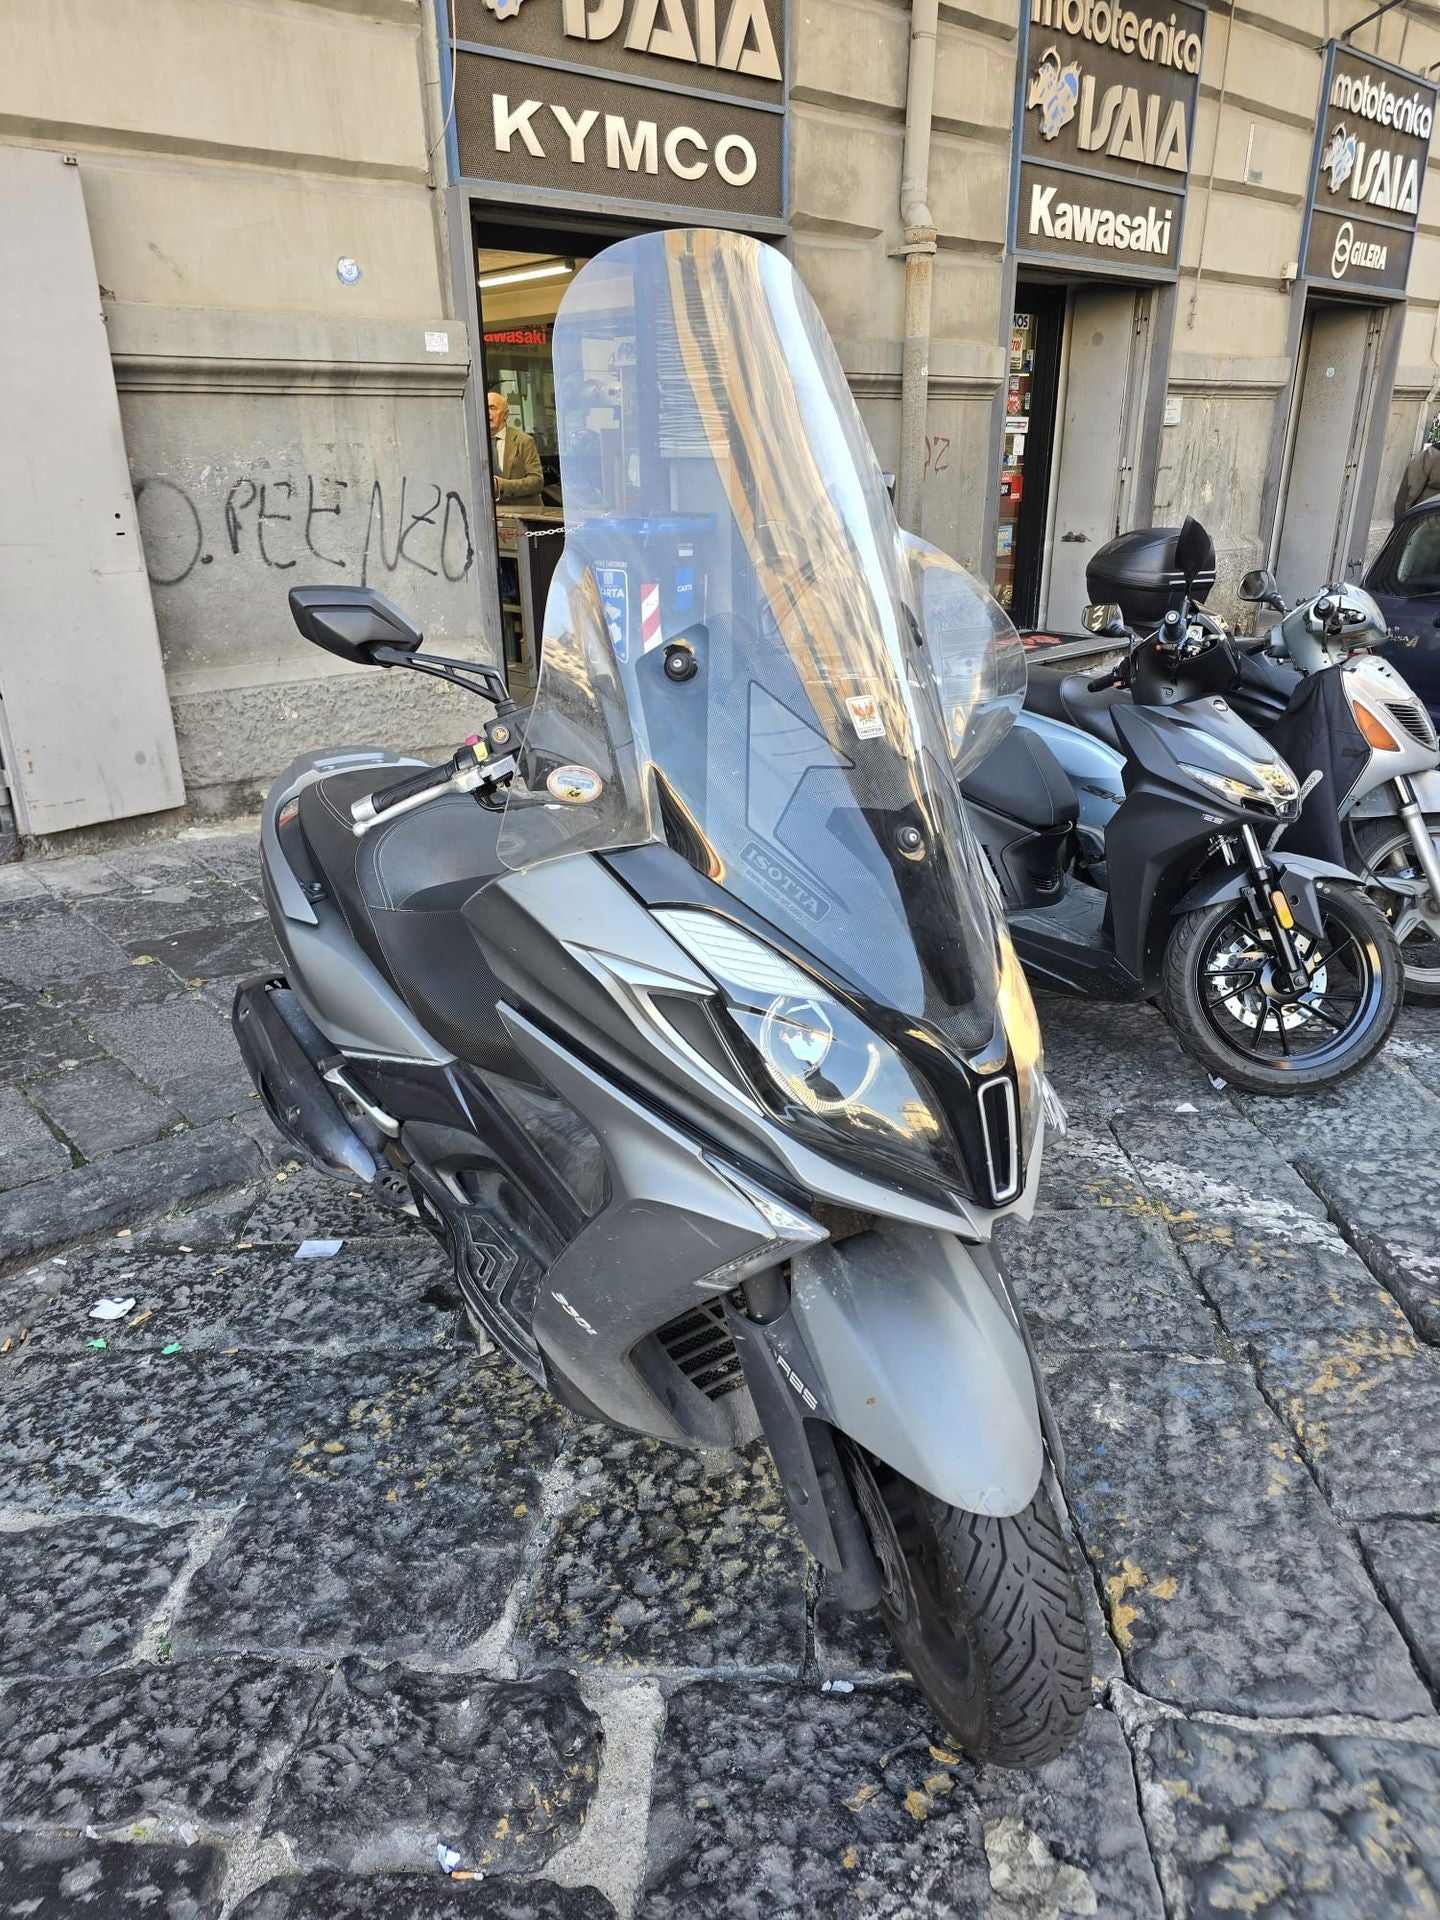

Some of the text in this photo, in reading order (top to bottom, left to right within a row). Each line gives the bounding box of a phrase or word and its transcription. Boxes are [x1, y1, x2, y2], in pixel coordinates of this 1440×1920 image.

[1077, 75, 1188, 172] ISAIA
[1329, 71, 1432, 139] mototecnica
[492, 94, 757, 186] KYMCO
[1350, 142, 1418, 214] ISAIA
[1029, 184, 1172, 255] Kawasaki
[1350, 241, 1388, 270] GILERA
[748, 849, 819, 915] ISOTTA
[777, 1354, 818, 1411] ABS
